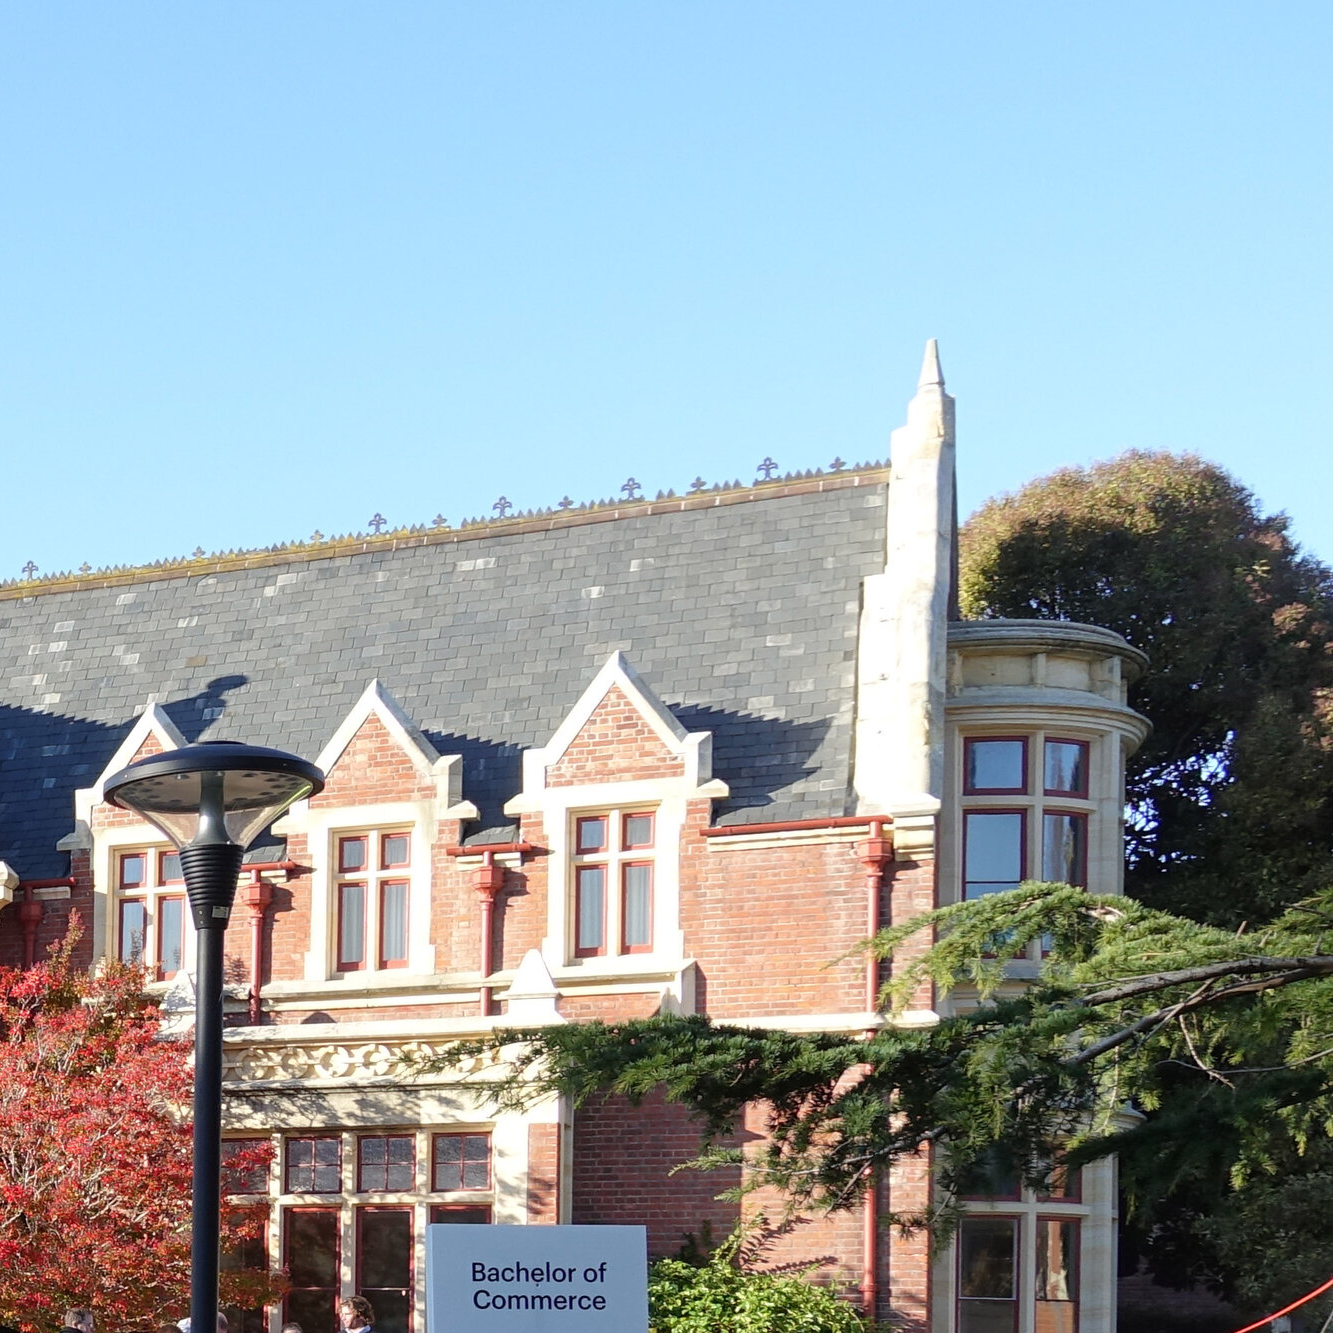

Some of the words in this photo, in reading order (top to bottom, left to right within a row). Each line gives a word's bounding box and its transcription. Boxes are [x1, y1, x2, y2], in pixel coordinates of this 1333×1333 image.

[471, 1261, 577, 1283] Bachelor
[583, 1261, 607, 1283] of
[473, 1289, 607, 1311] Commerce
